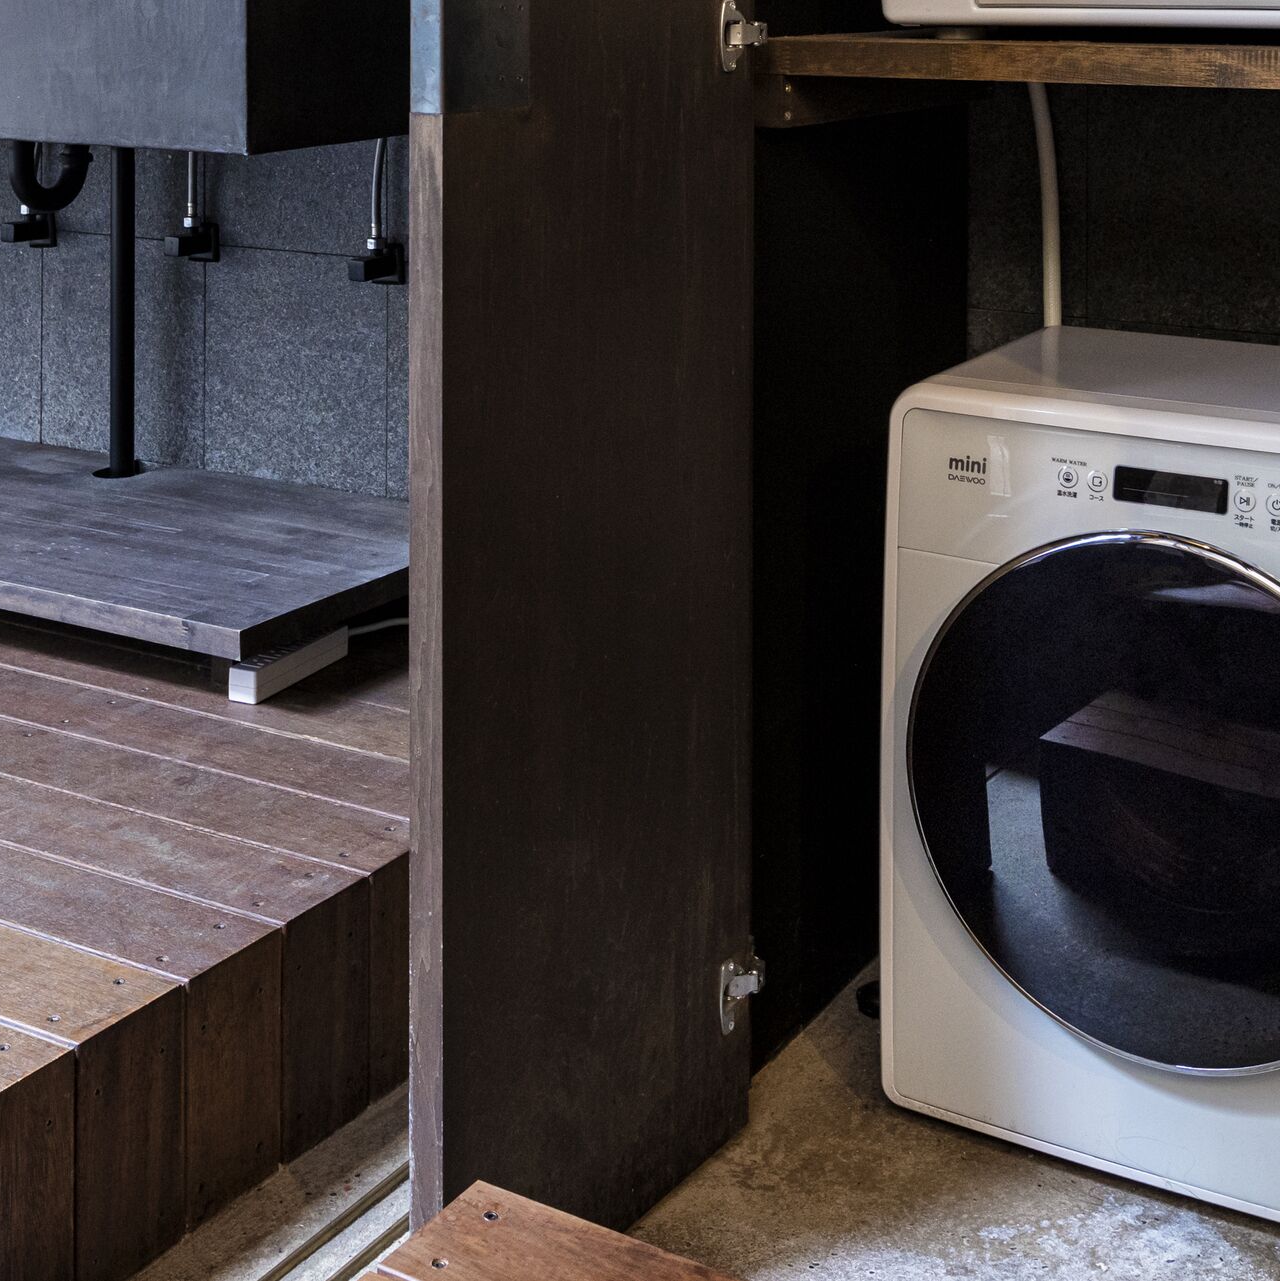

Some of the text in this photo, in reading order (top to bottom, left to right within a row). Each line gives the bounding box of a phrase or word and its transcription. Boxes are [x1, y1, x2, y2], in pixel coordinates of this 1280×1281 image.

[948, 455, 987, 475] mini
[948, 473, 986, 486] DAEWOO
[1236, 481, 1256, 489] PAUSE
[1089, 494, 1104, 502] コース
[1234, 514, 1255, 522] スタート
